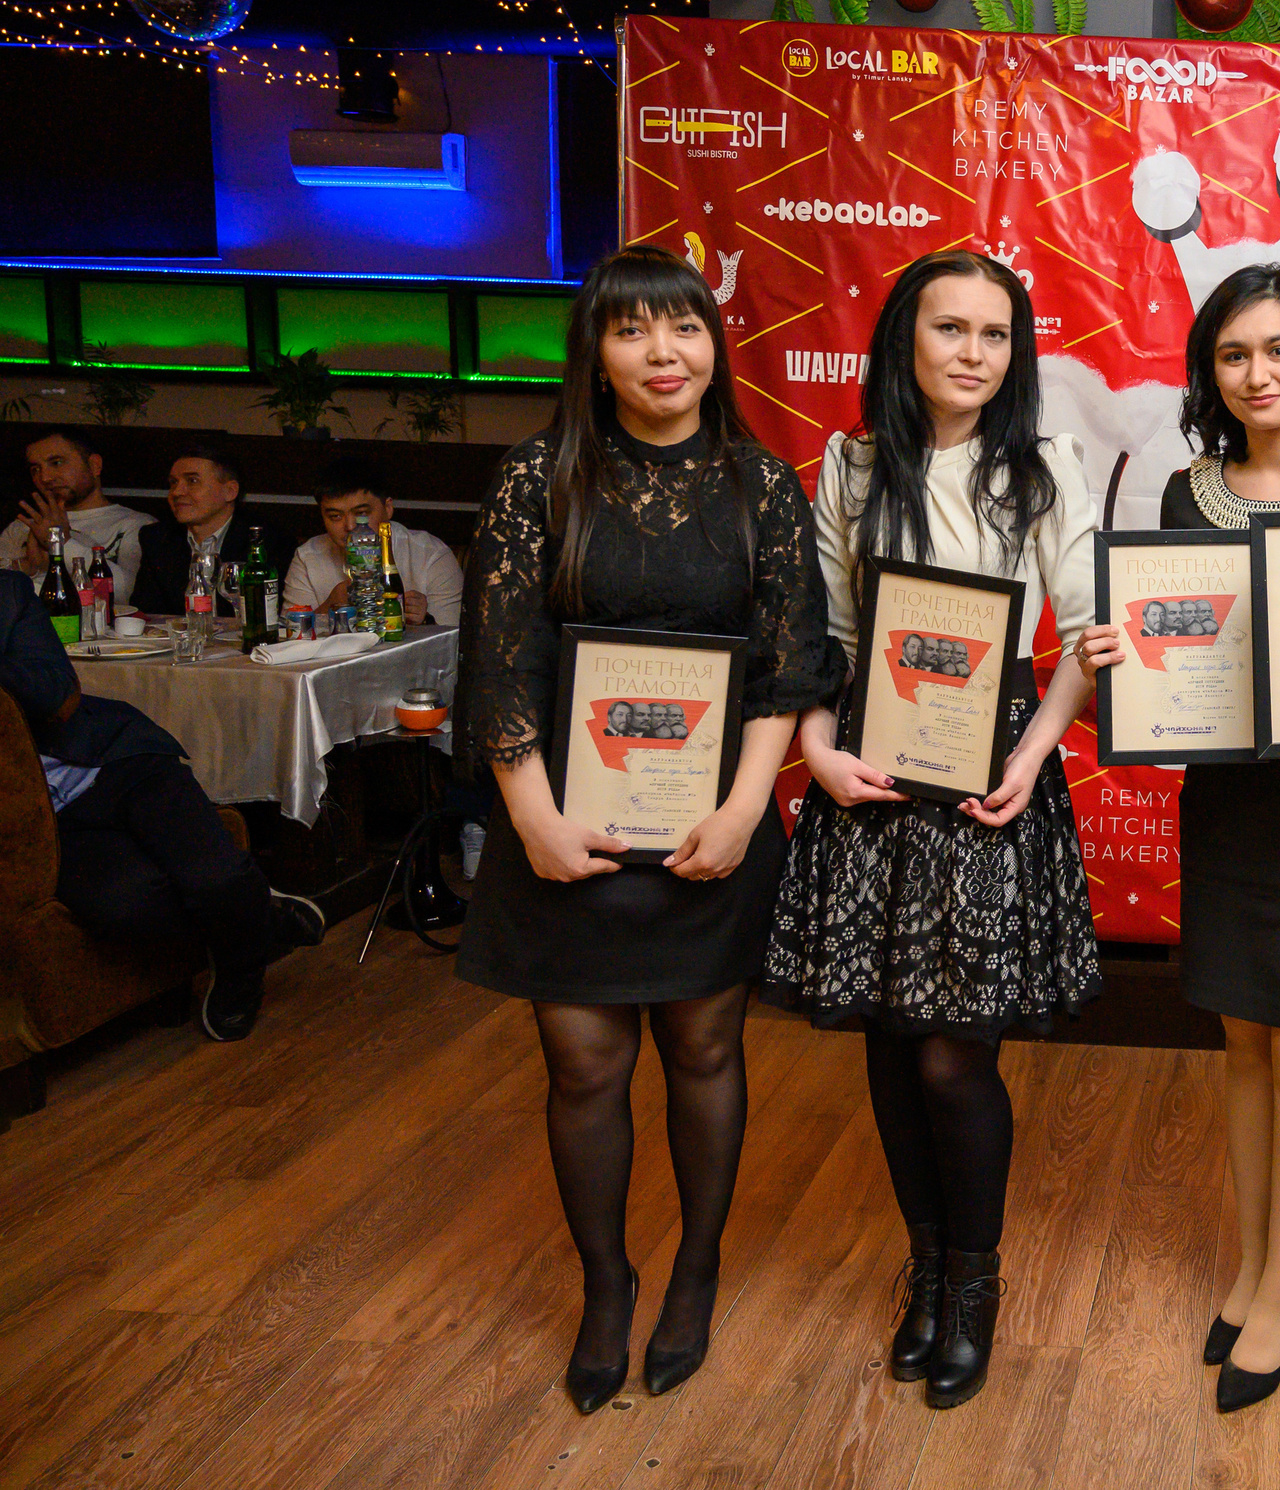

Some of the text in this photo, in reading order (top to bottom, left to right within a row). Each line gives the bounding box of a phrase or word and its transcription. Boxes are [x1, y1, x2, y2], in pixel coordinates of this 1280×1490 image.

[789, 55, 811, 68] BAR
[826, 46, 939, 75] LOCAL BAR
[887, 75, 913, 83] Lansky
[1127, 84, 1194, 104] BAZAR
[974, 99, 1048, 120] REMY
[640, 106, 787, 148] CUTFISH
[952, 128, 1068, 153] KITCHEN
[687, 149, 738, 159] SUSHI BISTRO
[955, 158, 1063, 181] BAKERY
[785, 350, 870, 385] ШАУР
[1126, 557, 1235, 574] ПОЧЕТНАЯ
[1137, 576, 1227, 593] ГРАМОТА
[893, 588, 995, 621] ПОЧЕТНАЯ
[901, 608, 984, 637] ГРАМОТА
[594, 656, 713, 679] ПОЧЕТНАЯ
[604, 676, 702, 697] ГРАМОТА
[1100, 788, 1171, 808] REMY
[1080, 815, 1174, 836] KITCHE
